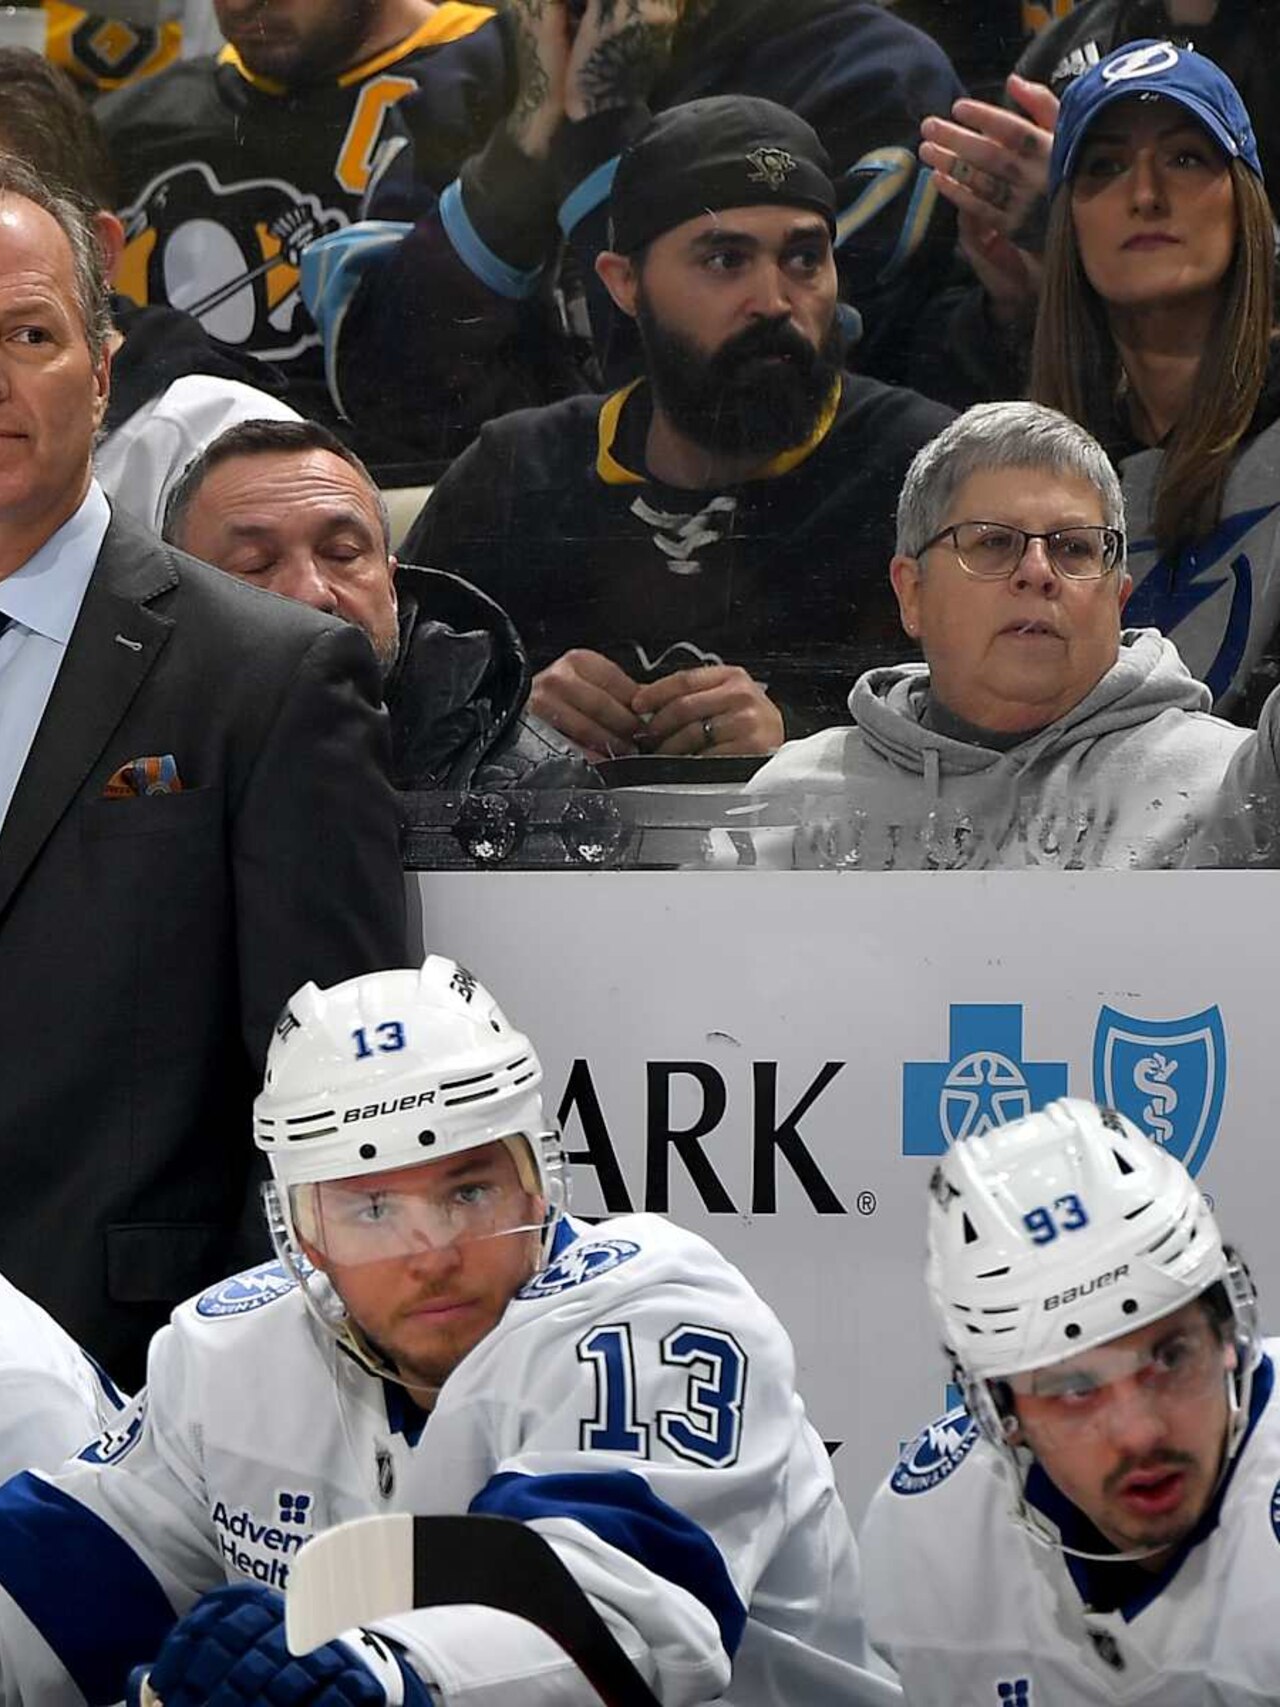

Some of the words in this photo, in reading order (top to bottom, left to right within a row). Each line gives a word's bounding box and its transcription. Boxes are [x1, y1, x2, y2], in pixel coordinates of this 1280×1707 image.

[351, 1020, 407, 1060] 13
[343, 1091, 436, 1123] BAUER
[1022, 1194, 1090, 1247] 93
[1043, 1264, 1130, 1311] BAUER
[575, 1322, 749, 1470] 13
[212, 1501, 314, 1555] Adven
[220, 1534, 290, 1591] Healt
